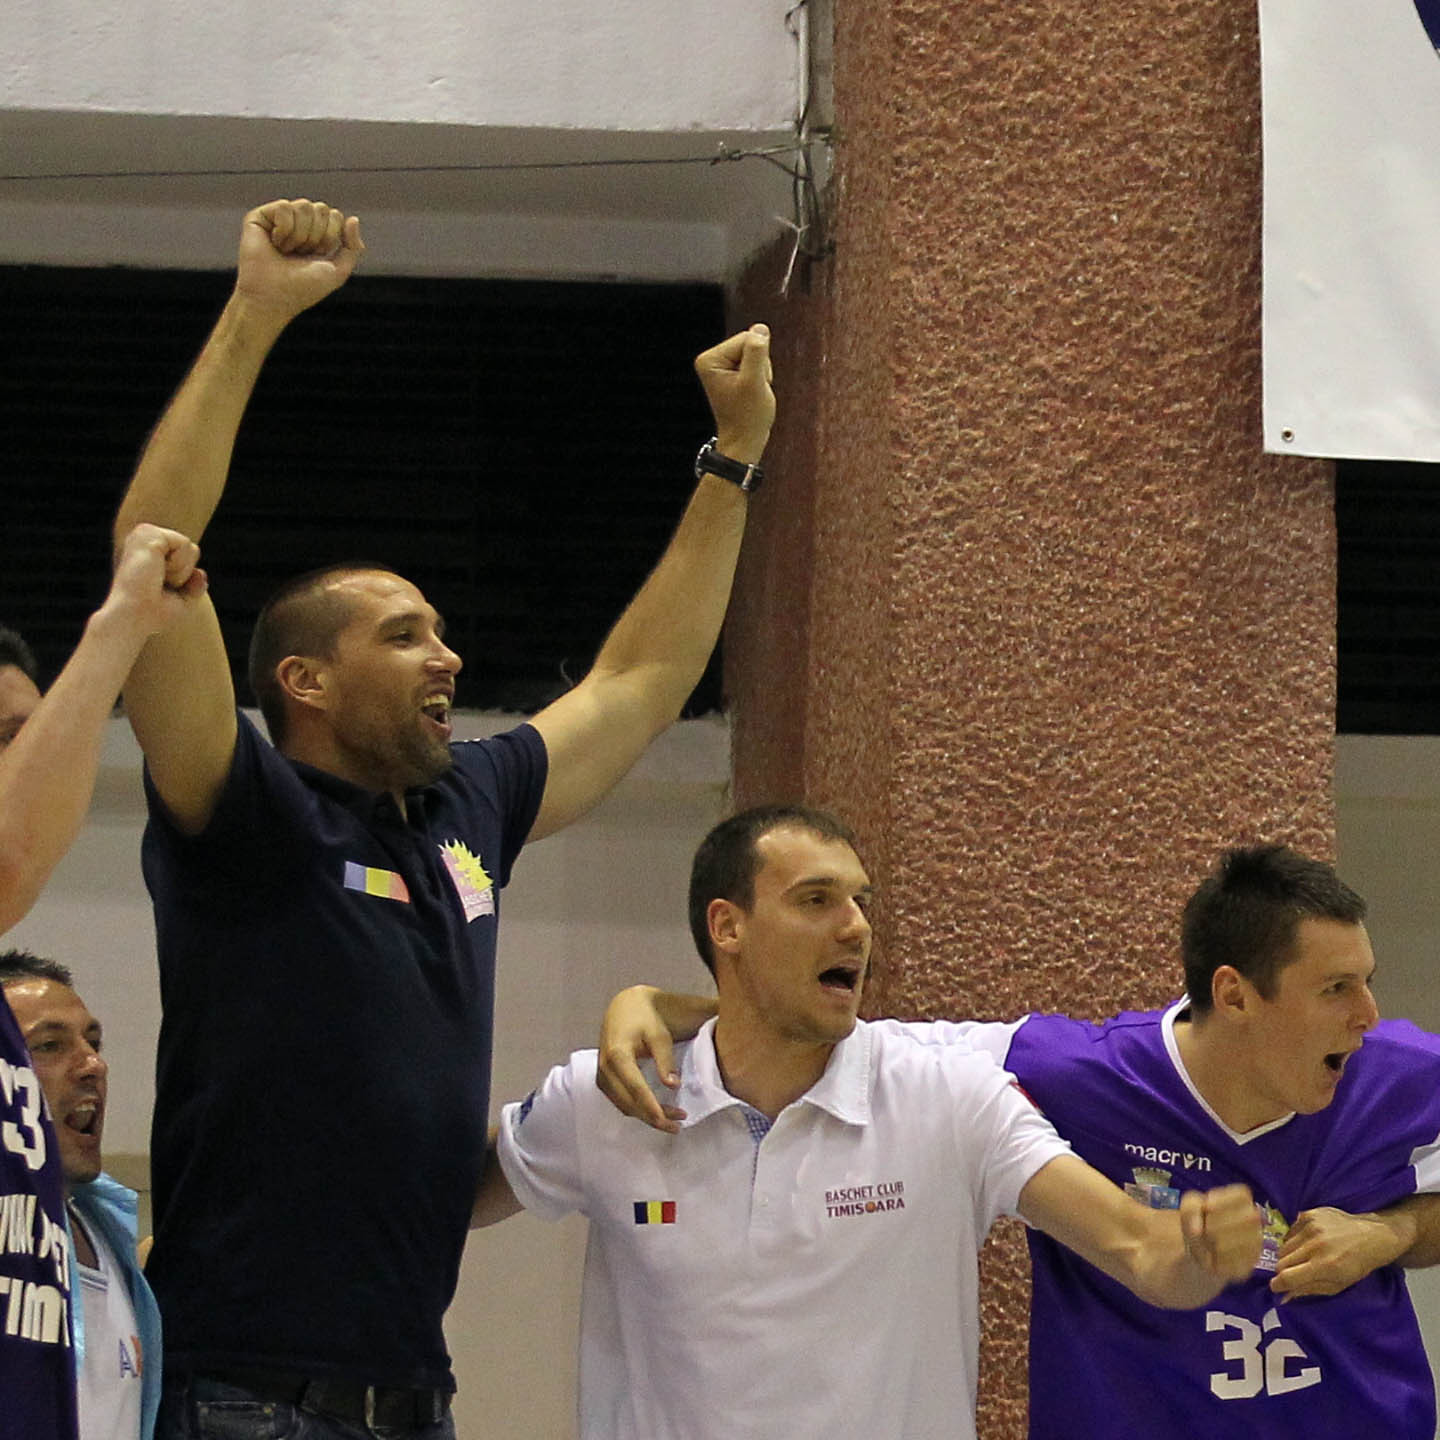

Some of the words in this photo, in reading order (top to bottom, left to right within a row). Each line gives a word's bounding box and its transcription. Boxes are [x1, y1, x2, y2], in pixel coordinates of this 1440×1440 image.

[1125, 1143, 1212, 1172] macron
[825, 1185, 874, 1203] BASCHET
[876, 1181, 905, 1197] CLUB
[826, 1197, 905, 1218] TIMISOARA
[1205, 1307, 1322, 1400] 32
